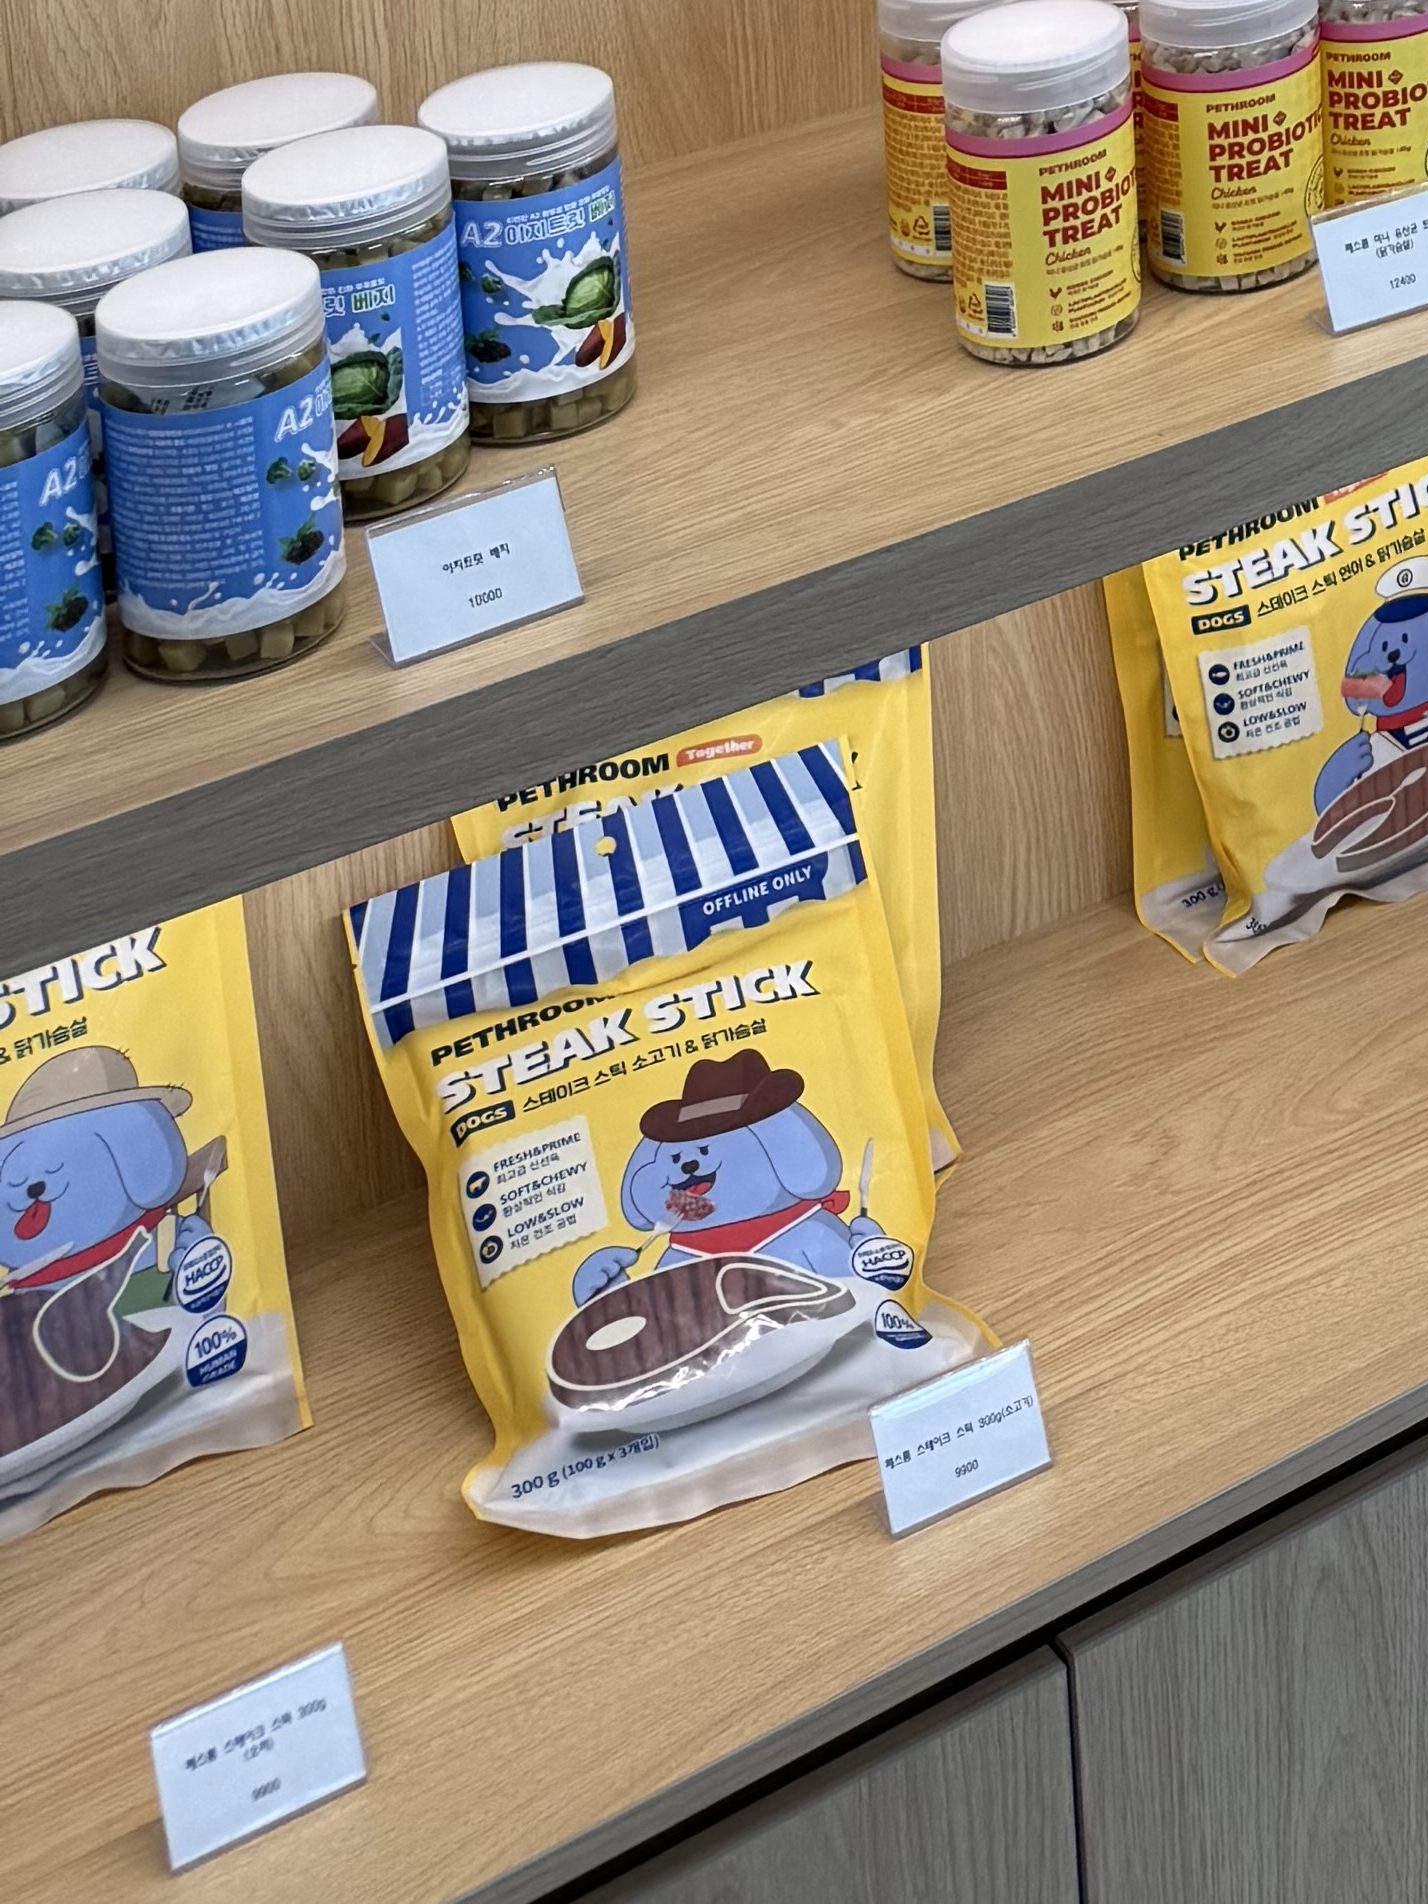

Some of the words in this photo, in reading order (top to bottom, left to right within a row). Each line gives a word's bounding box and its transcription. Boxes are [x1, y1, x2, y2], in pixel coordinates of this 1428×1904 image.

[1327, 70, 1382, 89] MINI
[1207, 113, 1268, 140] MINI
[1329, 107, 1411, 131] TREAT
[1209, 148, 1294, 183] TREAT
[1040, 171, 1101, 205] MINI
[1042, 204, 1123, 248] TREAT
[351, 284, 396, 313] 베지
[274, 398, 314, 443] A2
[39, 453, 78, 508] A2
[1182, 519, 1344, 608] STEAK
[1257, 584, 1309, 618] 스테이크
[1311, 574, 1338, 596] 스틱
[1338, 561, 1364, 583] 연어
[1365, 554, 1376, 569] &
[1198, 611, 1244, 630] DOGS
[1238, 670, 1310, 700] SOFT&CHEWY
[1243, 701, 1308, 727] LOW&SLOW
[684, 737, 755, 761] Together
[702, 880, 770, 916] OFFLINE
[772, 865, 812, 891] ONLY
[14, 1016, 88, 1059] 닭가슴살
[431, 994, 616, 1067] PETHROOM
[439, 1007, 640, 1115] STEAK
[644, 959, 821, 1035] STICK
[523, 1072, 593, 1113] 스테이크
[593, 1061, 627, 1086] 스틱
[631, 1042, 682, 1072] 소고기
[685, 1037, 699, 1054] &
[701, 1017, 768, 1051] 닭가슴살
[456, 1106, 508, 1140] DOGS
[493, 1132, 581, 1173] FRESH&PRIME
[500, 1162, 588, 1206] SOFT&CHEWY
[507, 1196, 585, 1238] LOW&SLOW
[184, 1255, 223, 1287] HACCP
[861, 1250, 906, 1269] HACCP
[881, 1312, 915, 1330] 100%
[194, 1326, 238, 1359] 100%
[511, 1475, 544, 1499] 300
[547, 1470, 560, 1488] g
[562, 1458, 593, 1481] (100
[596, 1455, 607, 1469] g
[608, 1451, 616, 1462] x
[618, 1433, 660, 1458] 3개입)
